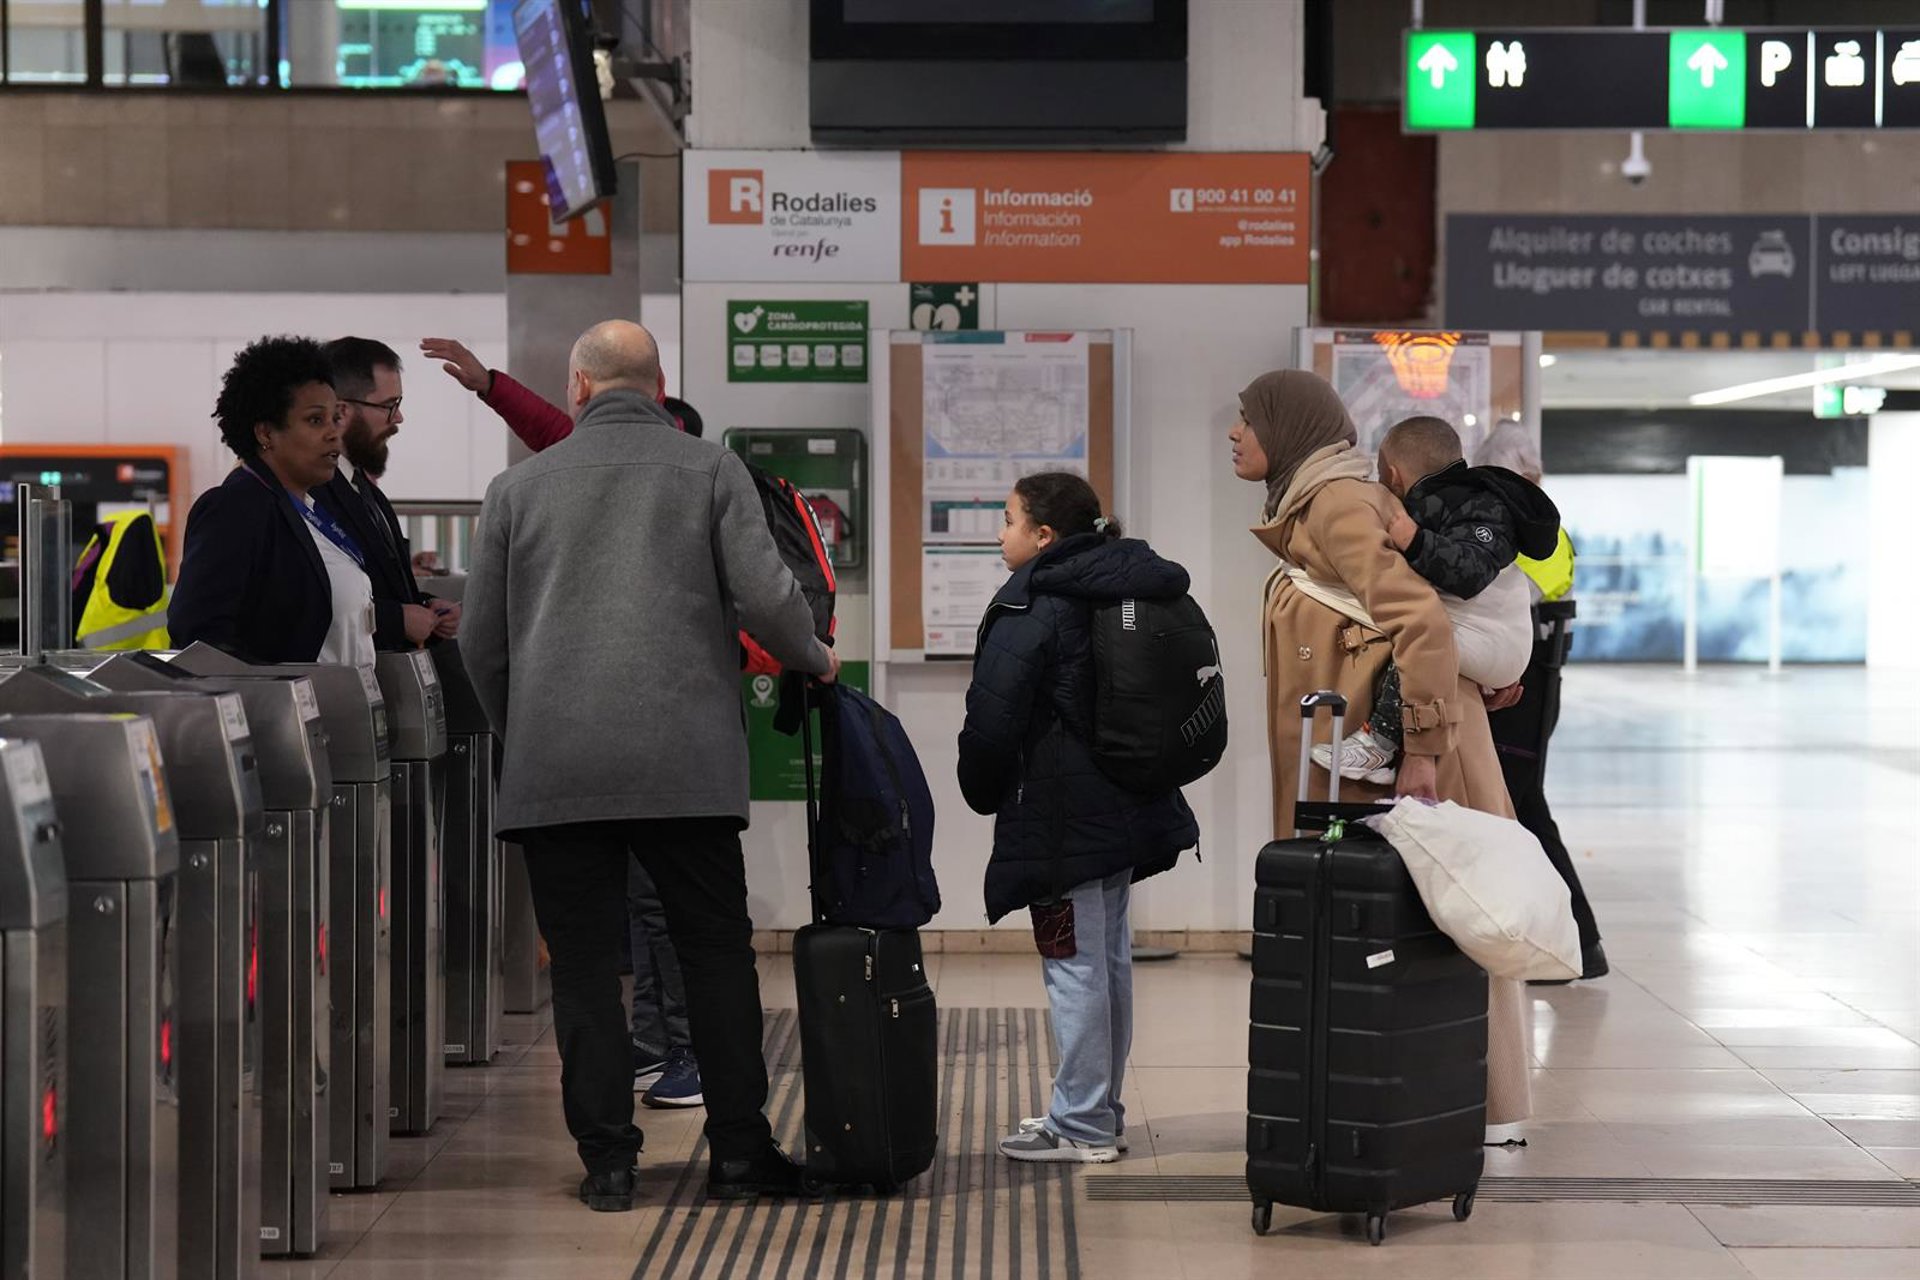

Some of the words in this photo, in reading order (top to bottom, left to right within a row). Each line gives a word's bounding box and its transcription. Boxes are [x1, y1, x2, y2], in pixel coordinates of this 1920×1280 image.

[1761, 40, 1792, 87] P
[772, 192, 877, 213] Rodalies
[984, 187, 1093, 207] Informació
[1196, 188, 1226, 204] 900
[1230, 188, 1248, 203] 41
[1254, 188, 1274, 204] 00
[1278, 188, 1296, 203] 41
[770, 215, 786, 226] de
[789, 214, 852, 229] Catalunya
[984, 210, 1081, 227] Información
[1238, 219, 1295, 232] @rodalies
[984, 230, 1081, 247] Information
[1220, 236, 1242, 247] app
[1244, 234, 1295, 246] Rodalies
[1488, 226, 1593, 256] Alquiler
[1600, 227, 1635, 254] de
[1642, 228, 1733, 254] coches
[773, 238, 839, 264] renfe
[1493, 262, 1595, 294] Lloguer
[1601, 262, 1638, 289] de
[1644, 264, 1734, 289] cotxes
[1638, 298, 1670, 316] CAR
[1673, 298, 1733, 316] RENTAL
[768, 312, 796, 321] ZONA
[768, 322, 863, 331] CARDIOPROTEGIDA
